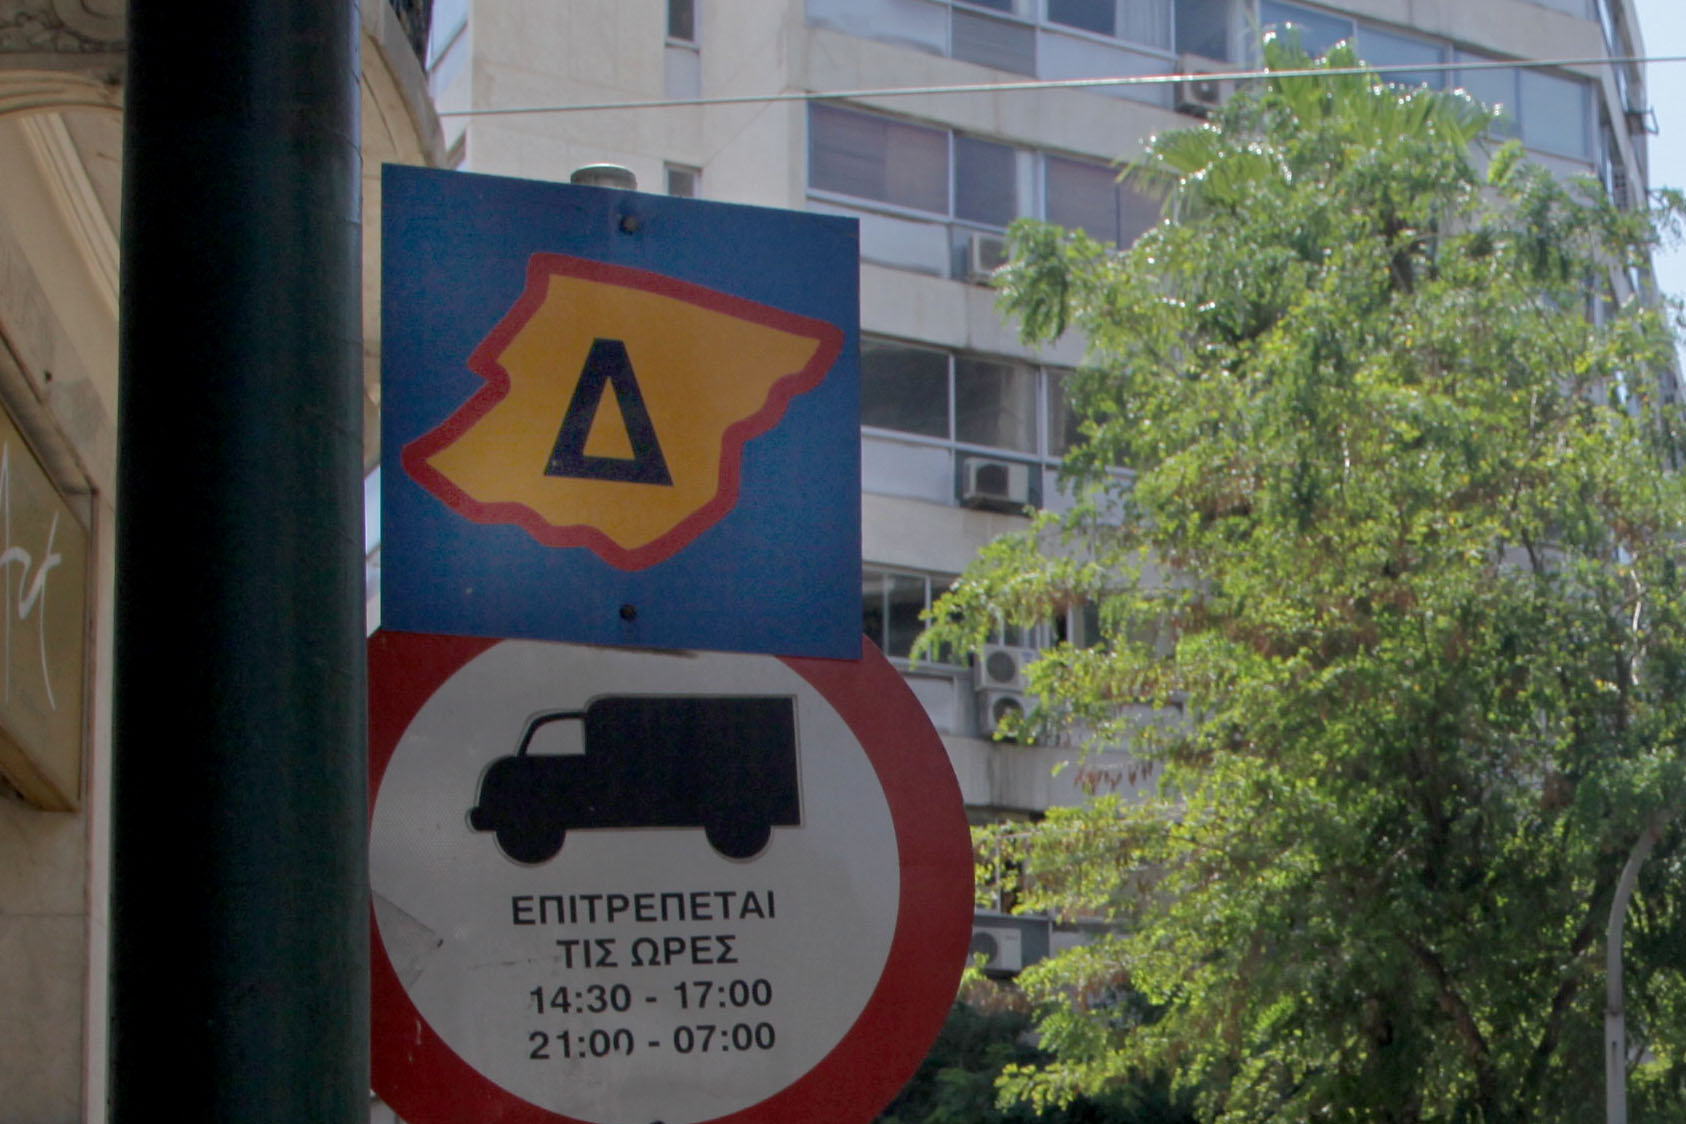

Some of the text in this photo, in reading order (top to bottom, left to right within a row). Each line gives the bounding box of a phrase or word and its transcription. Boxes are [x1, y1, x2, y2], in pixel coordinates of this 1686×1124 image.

[543, 337, 675, 488] Δ
[511, 890, 776, 926] ΕΠΙΤΡΕΠΕΤΑΙ
[556, 934, 739, 969] ΤΙΣ ΩΡΕΣ
[529, 983, 633, 1015] 14:30
[673, 978, 774, 1010] 17:00
[528, 1028, 635, 1060] 21:00
[672, 1021, 777, 1055] 07:00
